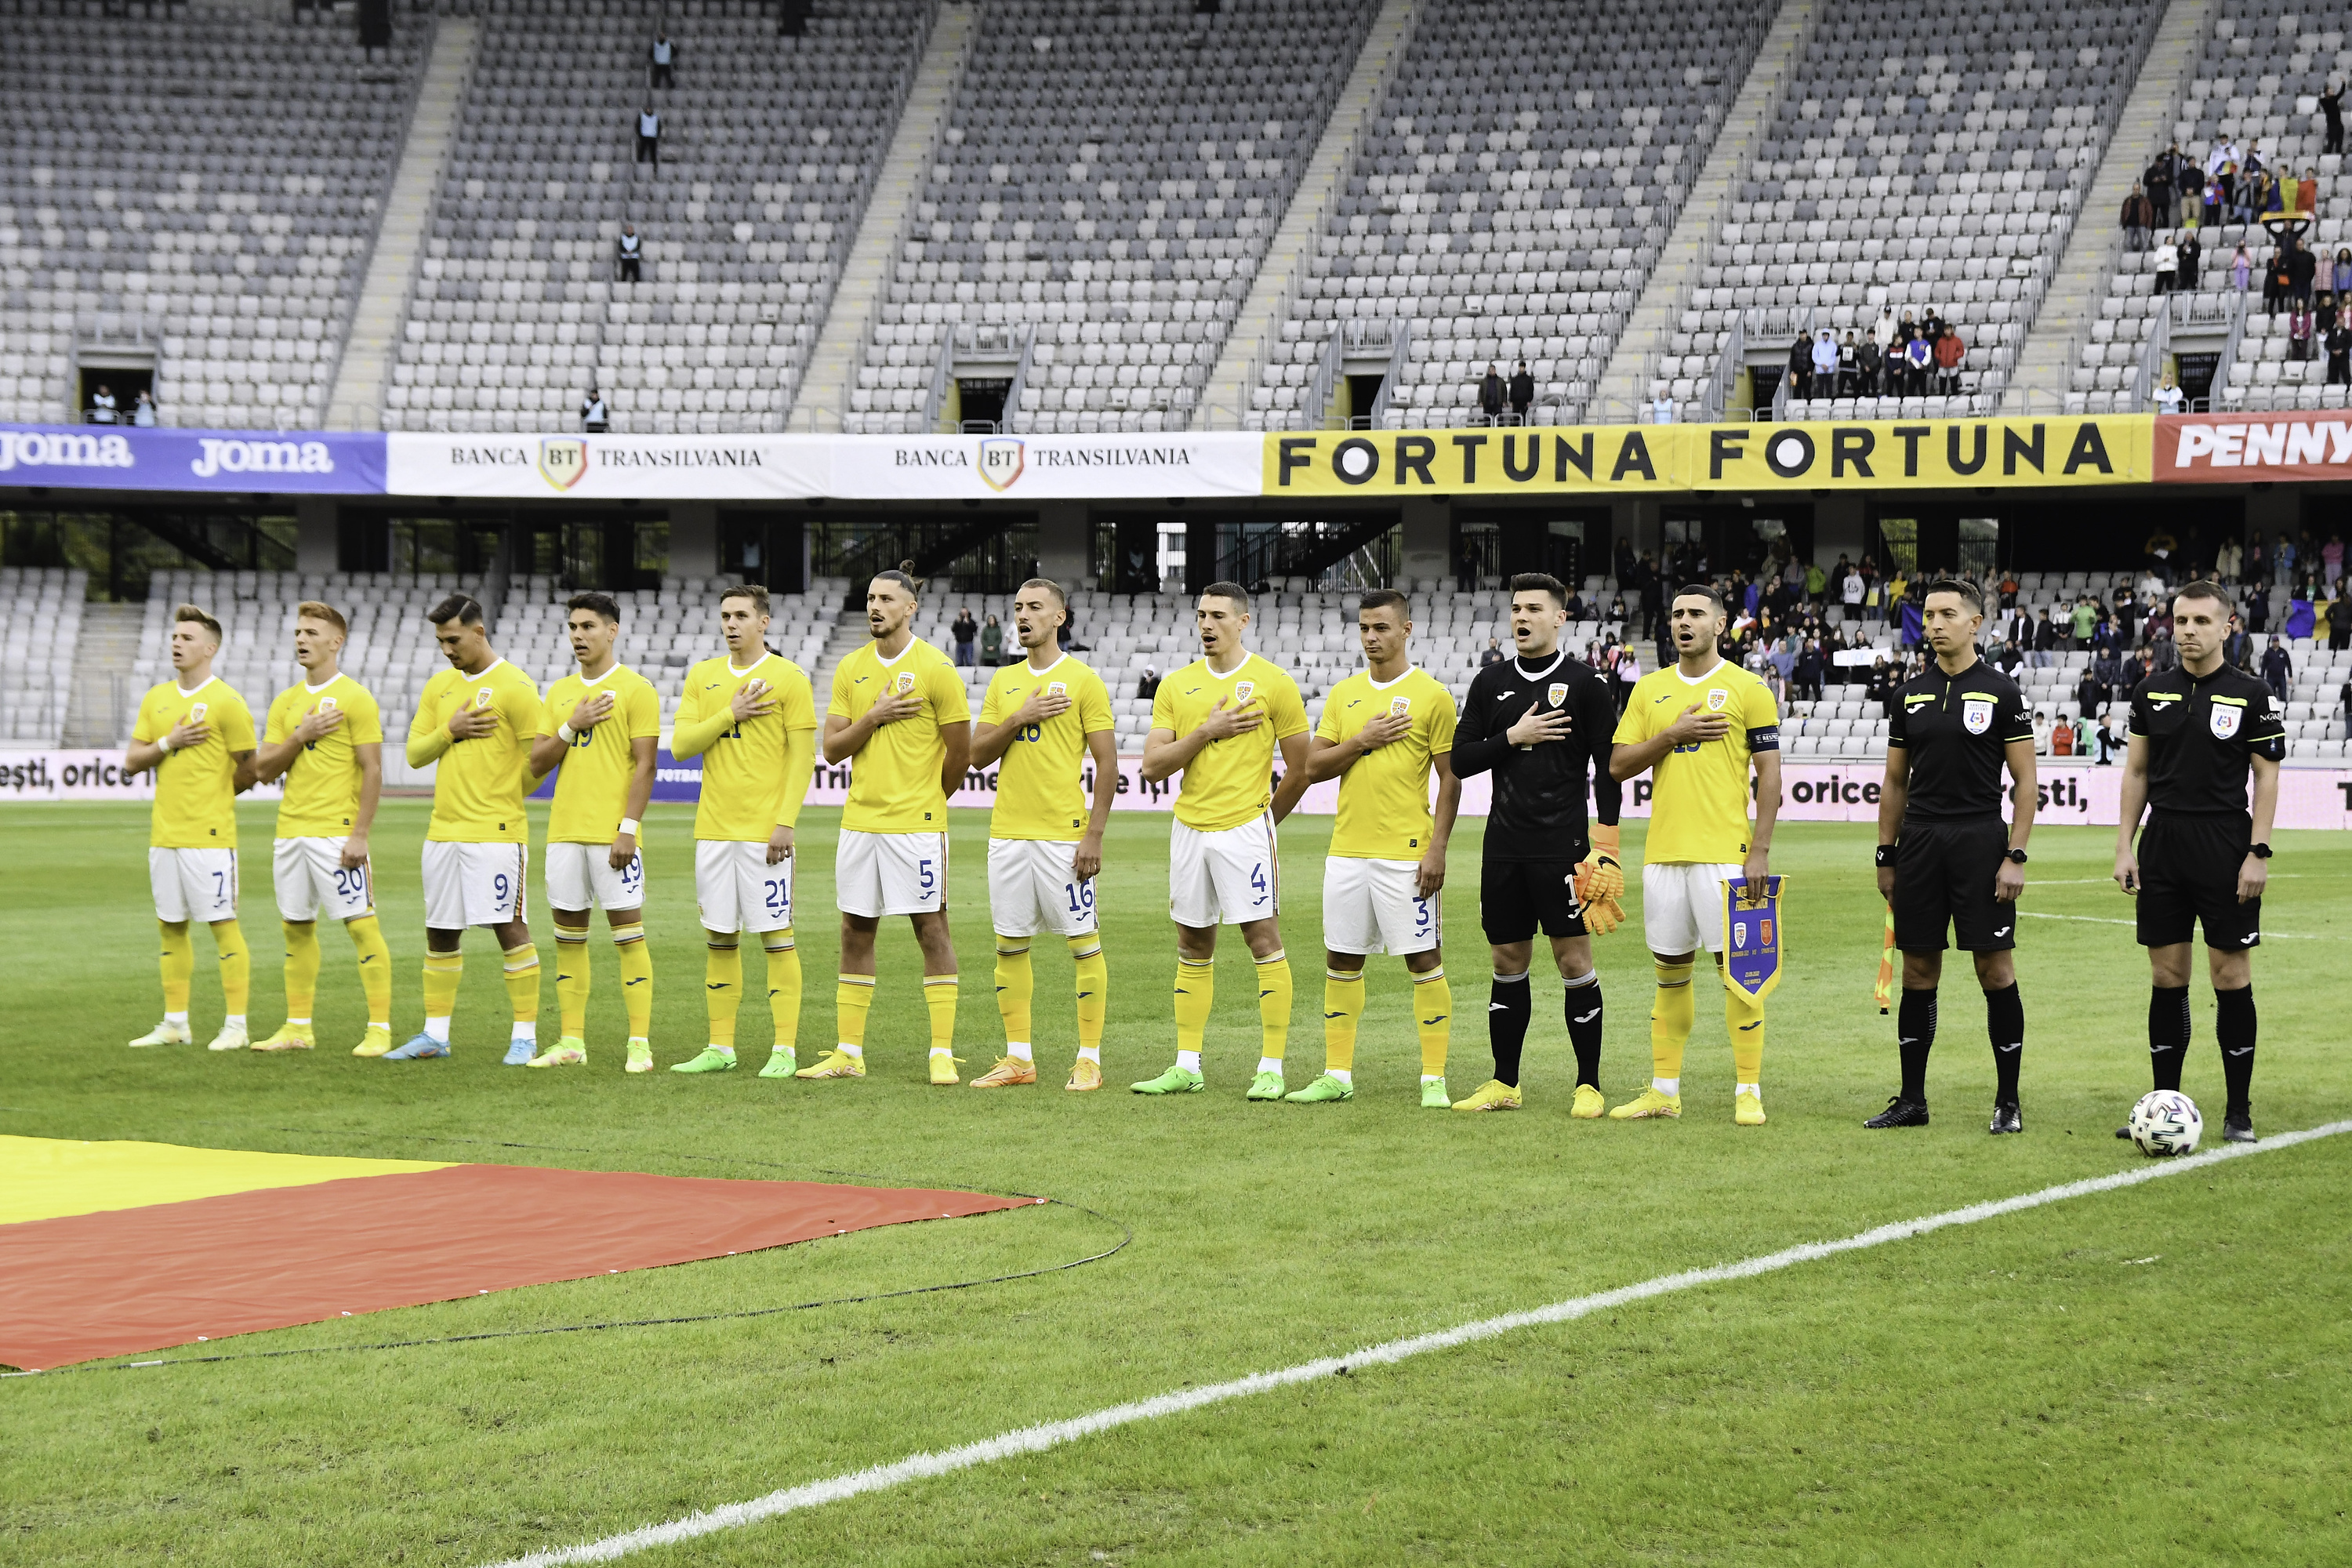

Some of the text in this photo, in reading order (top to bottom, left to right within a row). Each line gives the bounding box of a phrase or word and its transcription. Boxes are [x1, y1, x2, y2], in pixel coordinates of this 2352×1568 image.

[452, 448, 762, 466] BANCA BT TRANSILVANIA
[895, 448, 1190, 466] BANCA BT TRANSILVANIA
[1279, 430, 1657, 486] FORTUNA
[1709, 423, 2114, 480] FORTUNA
[2175, 421, 2352, 467] PENNY
[814, 764, 852, 789] Tri
[1791, 775, 1881, 804] orice
[212, 871, 223, 897] 7
[335, 868, 363, 895] 20
[622, 855, 642, 884] 19
[919, 859, 934, 887] 5
[1250, 862, 1266, 892] 4
[494, 873, 508, 900] 9
[764, 879, 789, 908] 21
[1065, 878, 1093, 912] 16
[1413, 897, 1429, 926] 3
